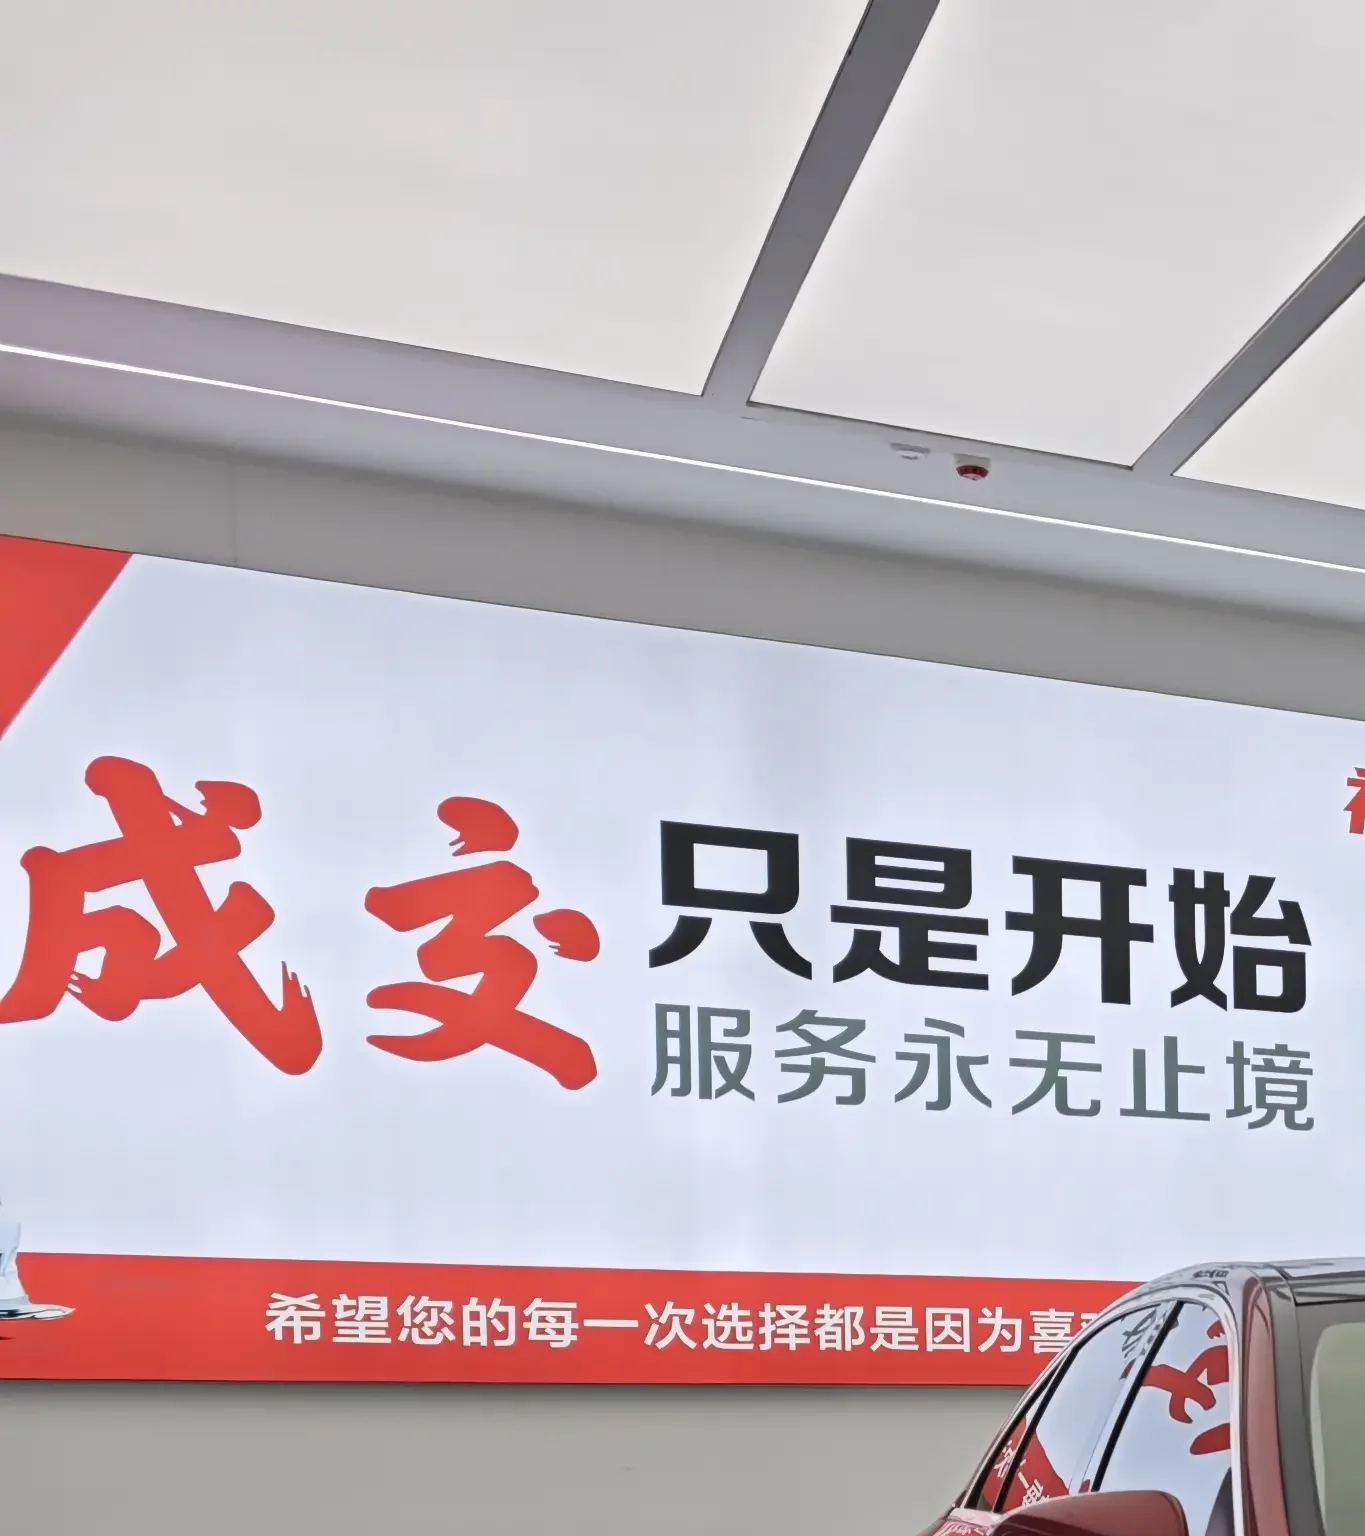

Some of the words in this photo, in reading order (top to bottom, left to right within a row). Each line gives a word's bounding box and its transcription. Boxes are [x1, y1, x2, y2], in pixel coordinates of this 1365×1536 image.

[0, 756, 599, 1090] 成交
[648, 820, 1312, 1014] 只是开始
[650, 1002, 1315, 1132] 服务永无止境
[265, 1292, 1099, 1355] 希望您的每一次选择都是因为喜
